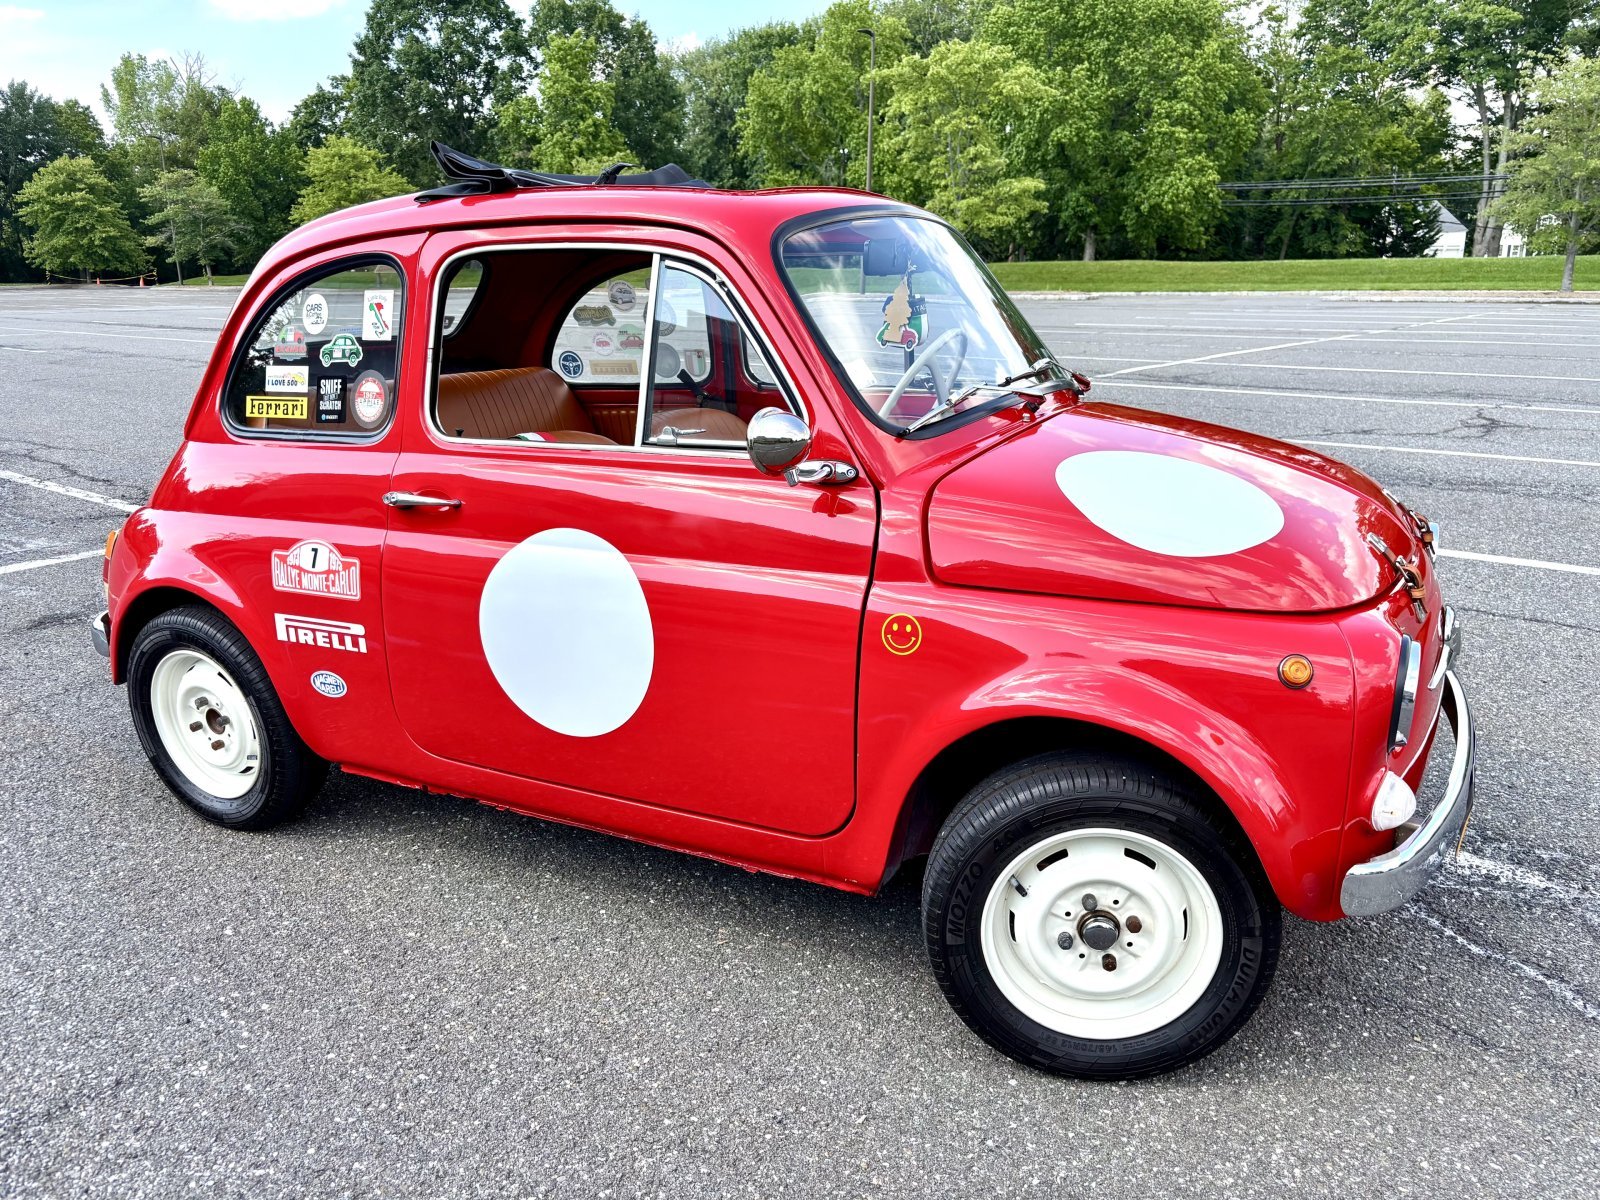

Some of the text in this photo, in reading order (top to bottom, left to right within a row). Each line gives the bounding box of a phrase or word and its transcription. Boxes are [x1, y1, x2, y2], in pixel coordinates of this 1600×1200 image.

[306, 303, 323, 312] CARS
[271, 379, 286, 387] LOVE
[286, 379, 298, 387] 500
[320, 378, 342, 395] SNIFF
[250, 398, 304, 416] Ferrari
[319, 400, 342, 410] SCRATCH
[311, 547, 319, 569] 7
[274, 556, 356, 595] RALLYE MONTE-CARLO
[274, 612, 368, 654] PIRELLI
[946, 861, 984, 940] MOZZO
